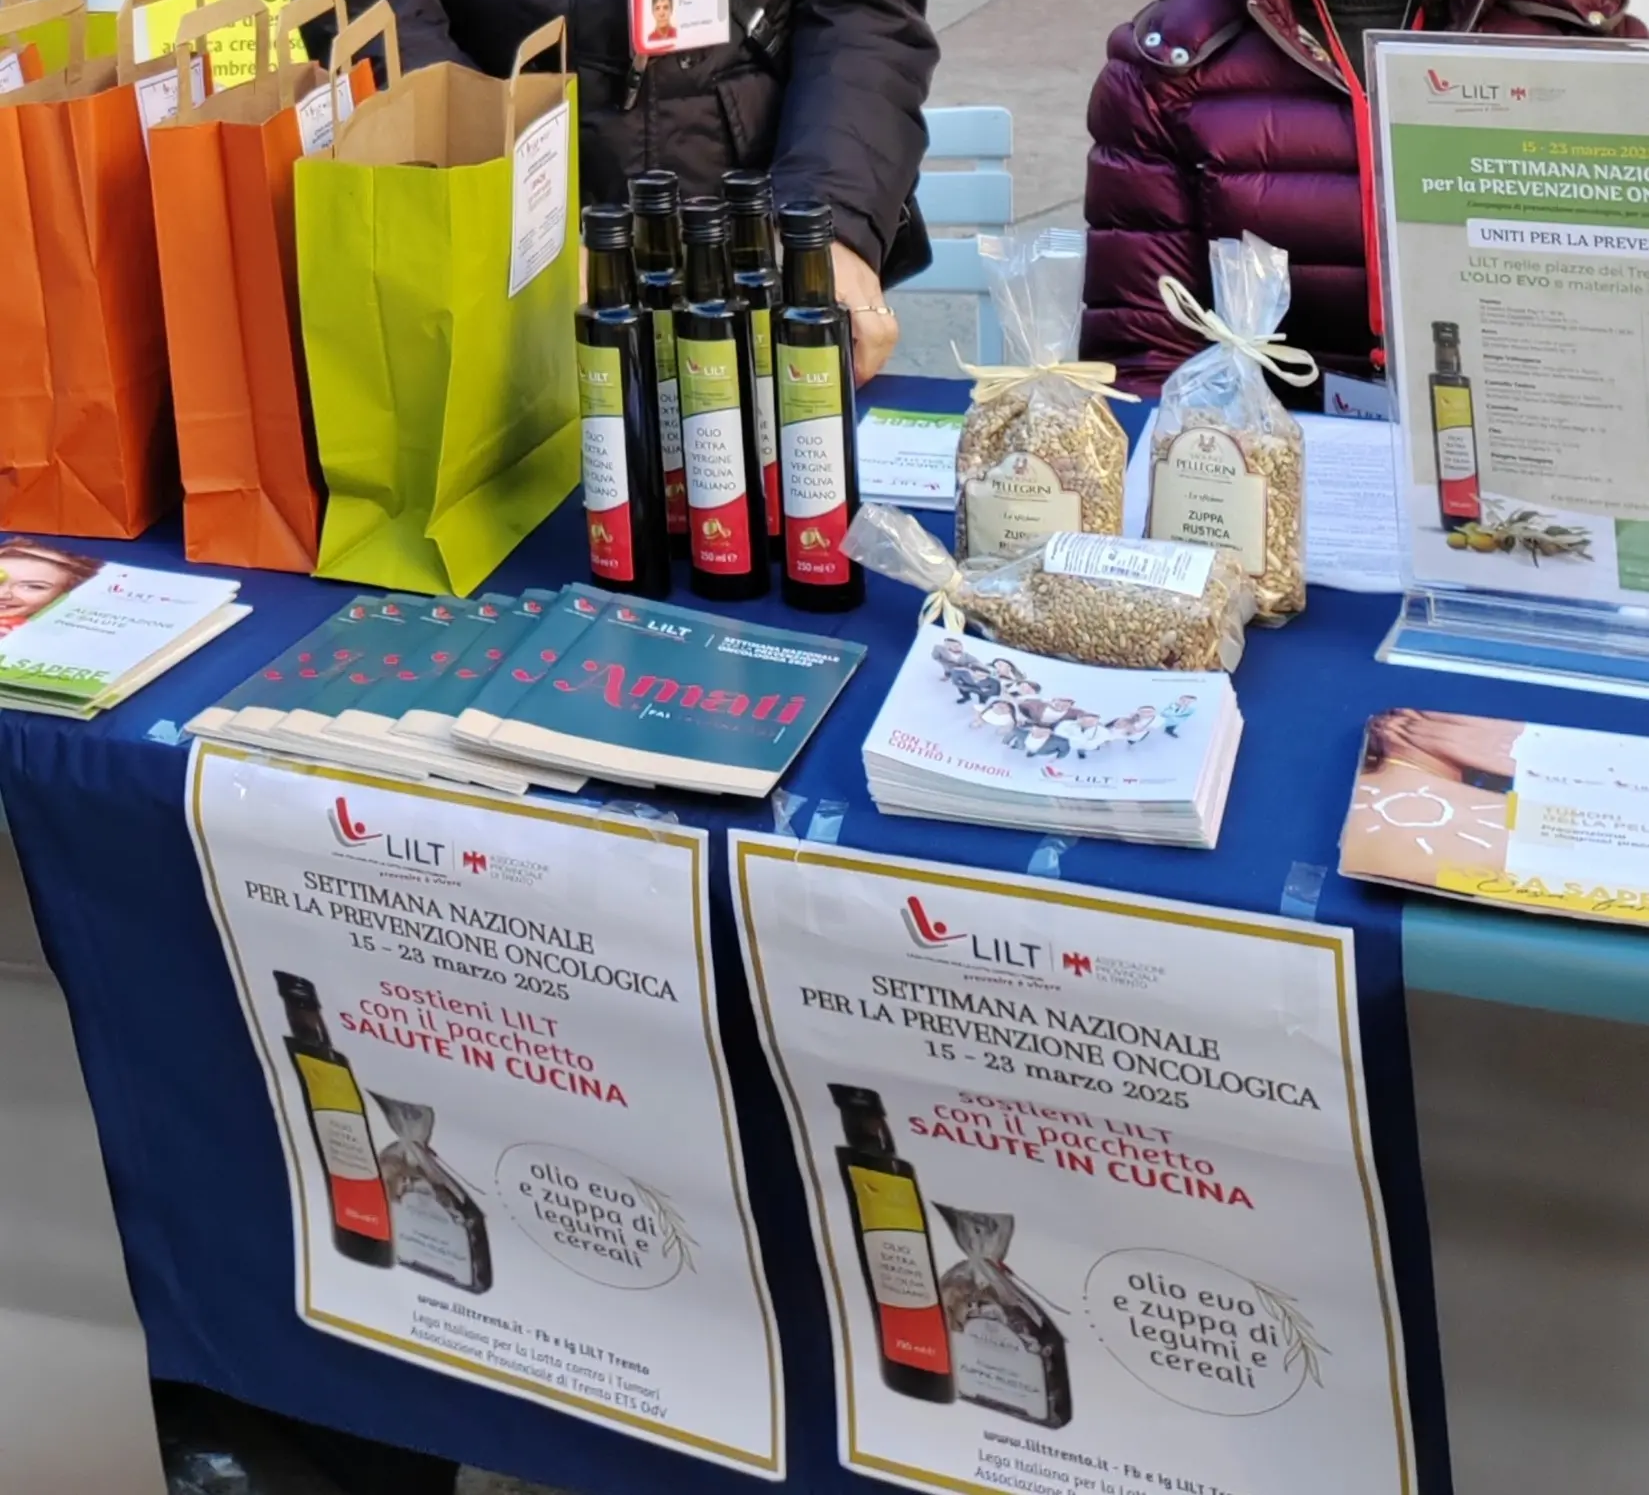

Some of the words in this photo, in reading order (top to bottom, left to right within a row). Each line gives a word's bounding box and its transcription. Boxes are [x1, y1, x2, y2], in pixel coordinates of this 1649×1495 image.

[1462, 85, 1500, 100] LILT
[1470, 157, 1590, 181] SETTIMANA
[1422, 177, 1454, 194] per
[1457, 176, 1476, 193] la
[1480, 179, 1621, 202] PREVENZIONE
[1481, 228, 1525, 243] UNITI
[1530, 231, 1562, 246] PER
[1567, 233, 1589, 247] LA
[1469, 256, 1499, 270] LILT
[1504, 258, 1541, 272] nelle
[1545, 260, 1596, 276] piazze
[1460, 272, 1511, 285] L'OLIO
[1516, 274, 1550, 288] EVO
[1568, 278, 1644, 295] materiale
[806, 372, 829, 384] LILT
[796, 435, 823, 446] OLIO
[794, 449, 828, 459] EXTRA
[790, 462, 833, 473] VERGINE
[1176, 458, 1237, 476] PELLEGRINI
[791, 475, 801, 485] DI
[803, 475, 834, 486] OLIVA
[992, 479, 1051, 495] PELLEGRINI
[790, 487, 837, 500] ITALIANO
[1188, 509, 1225, 525] ZUPPA
[1182, 523, 1231, 540] RUSTICA
[647, 620, 692, 637] LILT
[553, 660, 806, 725] Amati
[888, 738, 943, 762] CONTRO
[892, 729, 919, 744] CON
[925, 738, 940, 750] TE
[1075, 775, 1111, 785] LILT
[386, 834, 445, 866] LILT
[302, 870, 443, 920] SETTIMANA
[449, 902, 595, 955] NAZIONALE
[244, 880, 290, 908] PER
[293, 892, 324, 917] LA
[328, 900, 499, 959] PREVENZIONE
[504, 943, 679, 1003] ONCOLOGICA
[972, 934, 1041, 969] LILT
[349, 931, 376, 952] 15
[399, 944, 426, 964] 23
[432, 954, 507, 985] marzo
[514, 972, 571, 1001] 2025
[380, 980, 494, 1023] sostieni
[500, 1007, 558, 1038] LILT
[872, 975, 1038, 1026] SETTIMANA
[1046, 1008, 1221, 1061] NAZIONALE
[360, 999, 408, 1025] con
[417, 1007, 437, 1032] il
[446, 1019, 595, 1073] pacchetto
[339, 1011, 454, 1060] SALUTE
[461, 1043, 495, 1071] IN
[505, 1056, 629, 1108] CUCINA
[800, 986, 854, 1016] PER
[858, 999, 895, 1025] LA
[900, 1007, 1105, 1067] PREVENZIONE
[1112, 1049, 1321, 1111] ONCOLOGICA
[530, 1163, 578, 1191] olio
[519, 1181, 533, 1197] e
[542, 1187, 623, 1227] zuppa
[632, 1214, 657, 1237] di
[534, 1201, 627, 1247] legumi
[635, 1238, 649, 1253] e
[553, 1230, 642, 1269] cereali
[535, 1328, 551, 1344] Fb
[579, 1343, 604, 1362] LILT
[607, 1352, 650, 1376] Trento
